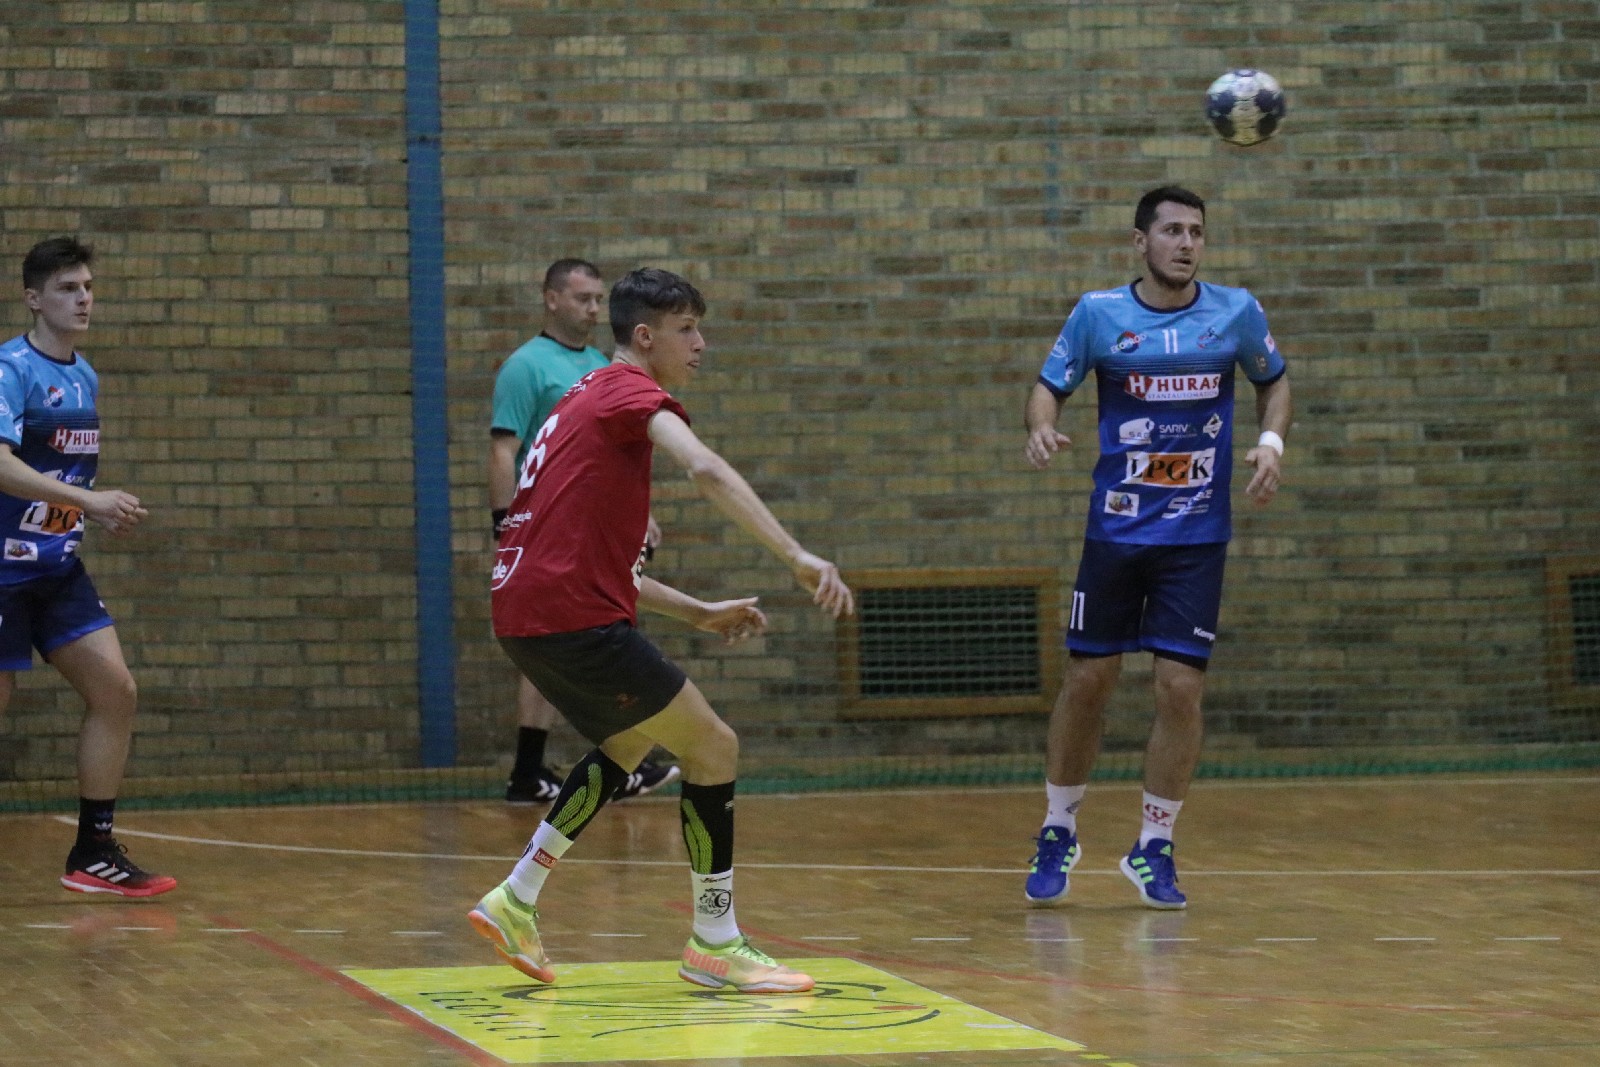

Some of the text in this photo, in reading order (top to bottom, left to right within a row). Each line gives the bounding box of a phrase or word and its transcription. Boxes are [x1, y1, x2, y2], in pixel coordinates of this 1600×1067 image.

[1162, 328, 1178, 354] 11
[1157, 375, 1219, 392] HURAS
[1131, 456, 1211, 481] LPGK
[1070, 590, 1085, 631] 11
[1193, 626, 1215, 642] Kemp
